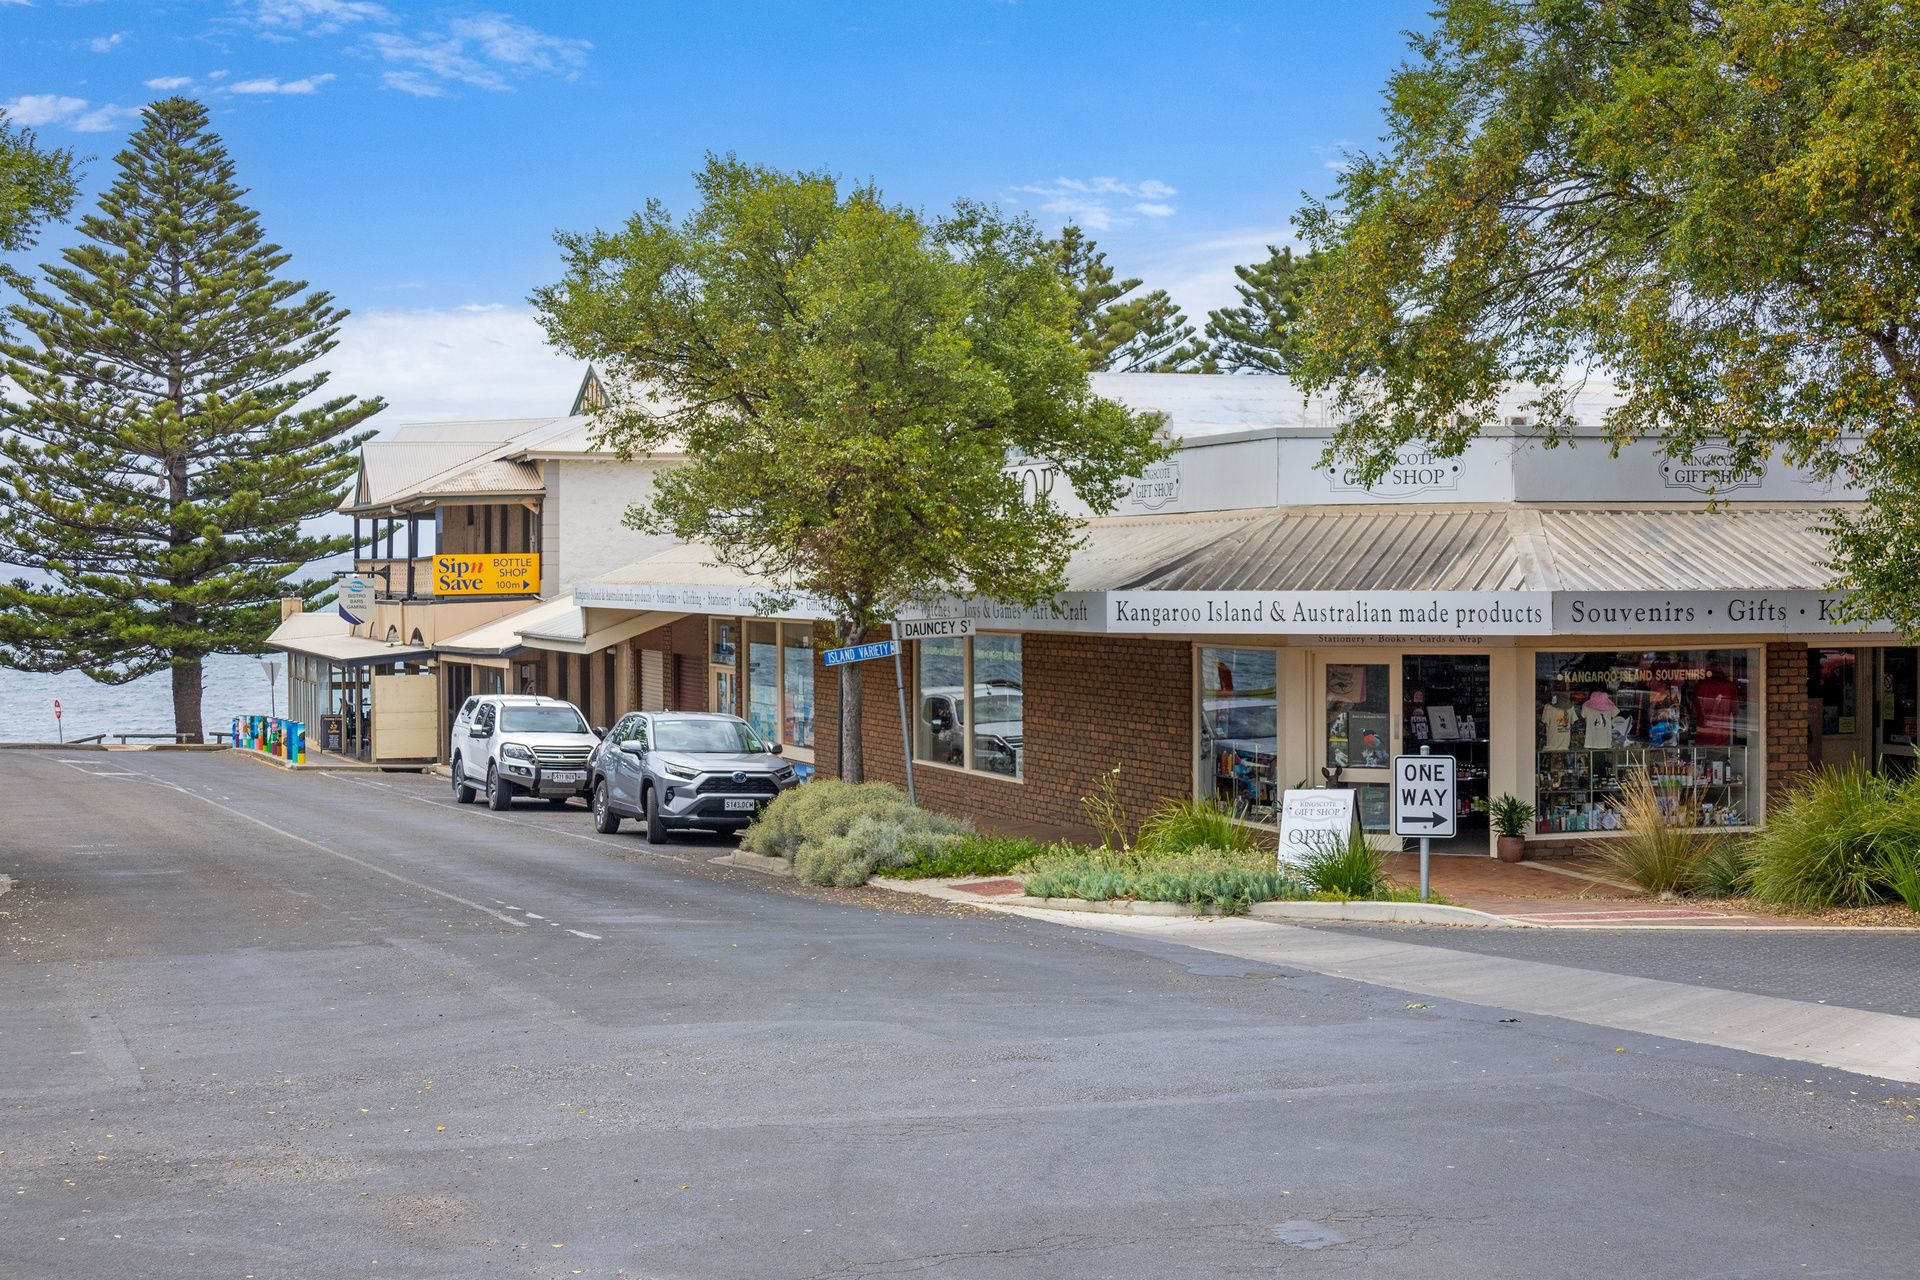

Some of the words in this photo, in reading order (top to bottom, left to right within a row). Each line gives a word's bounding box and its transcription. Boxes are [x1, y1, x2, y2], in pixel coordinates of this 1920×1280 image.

[1393, 469, 1445, 485] SHOP
[1135, 484, 1152, 499] GIFT
[1154, 482, 1174, 497] SHOP
[493, 558, 532, 567] BOTTLE
[499, 568, 528, 577] SHOP
[439, 575, 483, 591] Save
[496, 581, 520, 589] 100m
[983, 600, 991, 618] &
[992, 599, 1022, 619] Games
[1061, 599, 1088, 621] Craft
[1116, 600, 1201, 626] Kangaroo
[1207, 600, 1263, 621] Island
[1270, 600, 1286, 621] &
[1292, 600, 1392, 622] Australian
[1399, 600, 1449, 622] made
[1456, 600, 1542, 628] products
[1571, 600, 1695, 623] Souvenirs
[1728, 598, 1786, 621] Gifts
[905, 621, 956, 637] DAUNCEY
[1318, 634, 1365, 644] Stationery
[1378, 635, 1406, 643] Books
[1419, 635, 1446, 643] Cards
[1458, 635, 1483, 644] Wrap
[828, 649, 855, 664] ISLAND
[859, 643, 889, 659] VARIETY
[1564, 670, 1617, 683] KANGAROO
[1619, 669, 1652, 682] ISLAND
[1655, 668, 1706, 681] SOUVENIRS
[1404, 763, 1445, 781] ONE
[1300, 800, 1336, 808] KINGSCOTE
[1401, 788, 1448, 806] WAY
[1294, 808, 1314, 816] GIFT
[1316, 808, 1341, 816] SHOP
[1288, 828, 1342, 845] OPEN
